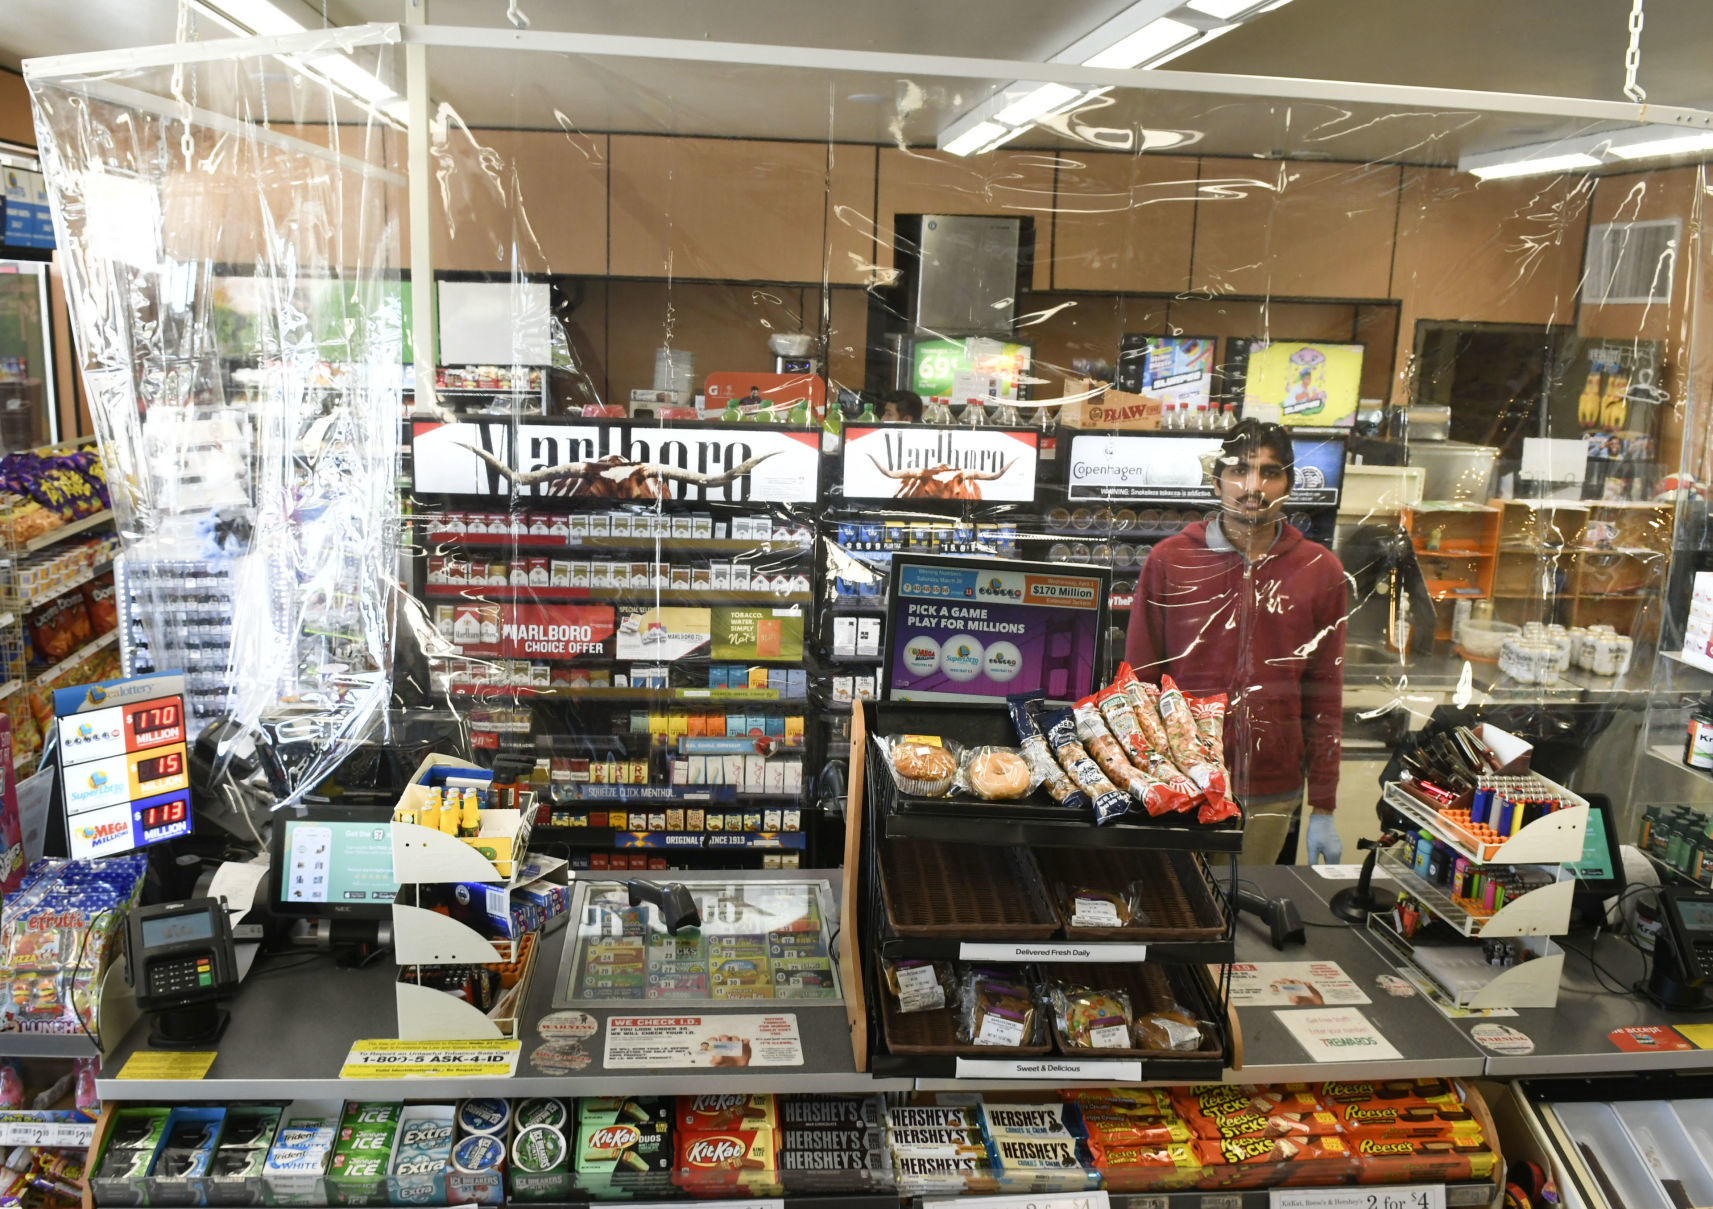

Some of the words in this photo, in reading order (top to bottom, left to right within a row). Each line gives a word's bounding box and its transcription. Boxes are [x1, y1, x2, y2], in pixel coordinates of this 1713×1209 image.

[708, 385, 718, 396] G
[1104, 404, 1146, 422] RAW
[1073, 461, 1142, 481] Copenhagen
[1032, 585, 1056, 596] $170
[1059, 587, 1092, 598] Million
[908, 604, 937, 616] PICK
[940, 606, 949, 616] A
[951, 607, 988, 619] GAME
[503, 624, 591, 641] MARLBORO
[908, 616, 937, 628] PLAY
[940, 618, 964, 630] FOR
[967, 621, 1025, 634] MILLIONS
[525, 641, 565, 653] CHOICE
[569, 642, 603, 654] OFFER
[126, 714, 133, 724] $
[140, 706, 175, 728] 170
[136, 727, 179, 745] MILLION
[158, 754, 178, 773] 15
[140, 776, 183, 792] MILLION
[134, 812, 141, 821] $
[149, 802, 185, 824] 113
[92, 821, 129, 839] MEGA
[144, 822, 187, 841] MILLION
[666, 836, 698, 845] ORIGINAL
[729, 836, 745, 845] 1913
[1016, 949, 1050, 957] Delivered
[1051, 949, 1071, 957] Fresh
[1072, 950, 1090, 958] Daily
[615, 1019, 633, 1027] WE
[637, 1018, 676, 1026] CHECK
[681, 1018, 699, 1026] I.D.
[1626, 1026, 1662, 1034] accept
[430, 1055, 505, 1063] ASK-4-ID
[1016, 1065, 1040, 1073] Sweet
[1322, 1080, 1375, 1097] Reese's
[786, 1102, 858, 1122] HERSHEY'S
[1202, 1097, 1250, 1118] STICKS
[1345, 1104, 1398, 1121] Reese's
[358, 1111, 391, 1123] ICE
[891, 1108, 962, 1127] HERSHEY'S
[991, 1110, 1057, 1127] HERSHEY'S
[283, 1131, 316, 1141] Trident
[404, 1126, 453, 1145] Extra
[1220, 1117, 1269, 1138] STICKS
[351, 1137, 386, 1150] ICE
[589, 1129, 636, 1149] KitKat
[638, 1135, 661, 1143] DUOS
[786, 1131, 860, 1150] HERSHEY'S
[893, 1129, 965, 1145] HERSHEY'S
[688, 1143, 741, 1163] KitKat
[1002, 1142, 1070, 1160] HERSHEY'S
[1225, 1139, 1275, 1164] STICKS
[1360, 1139, 1414, 1154] Reese's
[274, 1150, 307, 1161] Trident
[786, 1151, 863, 1170] HERSHEY'S
[281, 1162, 318, 1170] WHITE
[343, 1163, 379, 1176] ICE
[397, 1159, 446, 1176] Extra
[900, 1157, 975, 1176] HERSHEY'S
[450, 1176, 462, 1185] ICE
[462, 1175, 498, 1186] BREAKERS
[515, 1177, 527, 1186] ICE
[528, 1175, 563, 1186] BREAKERS
[401, 1185, 433, 1199] Extra
[1367, 1195, 1378, 1209] 2
[1384, 1195, 1406, 1209] for
[1411, 1192, 1430, 1209] $4
